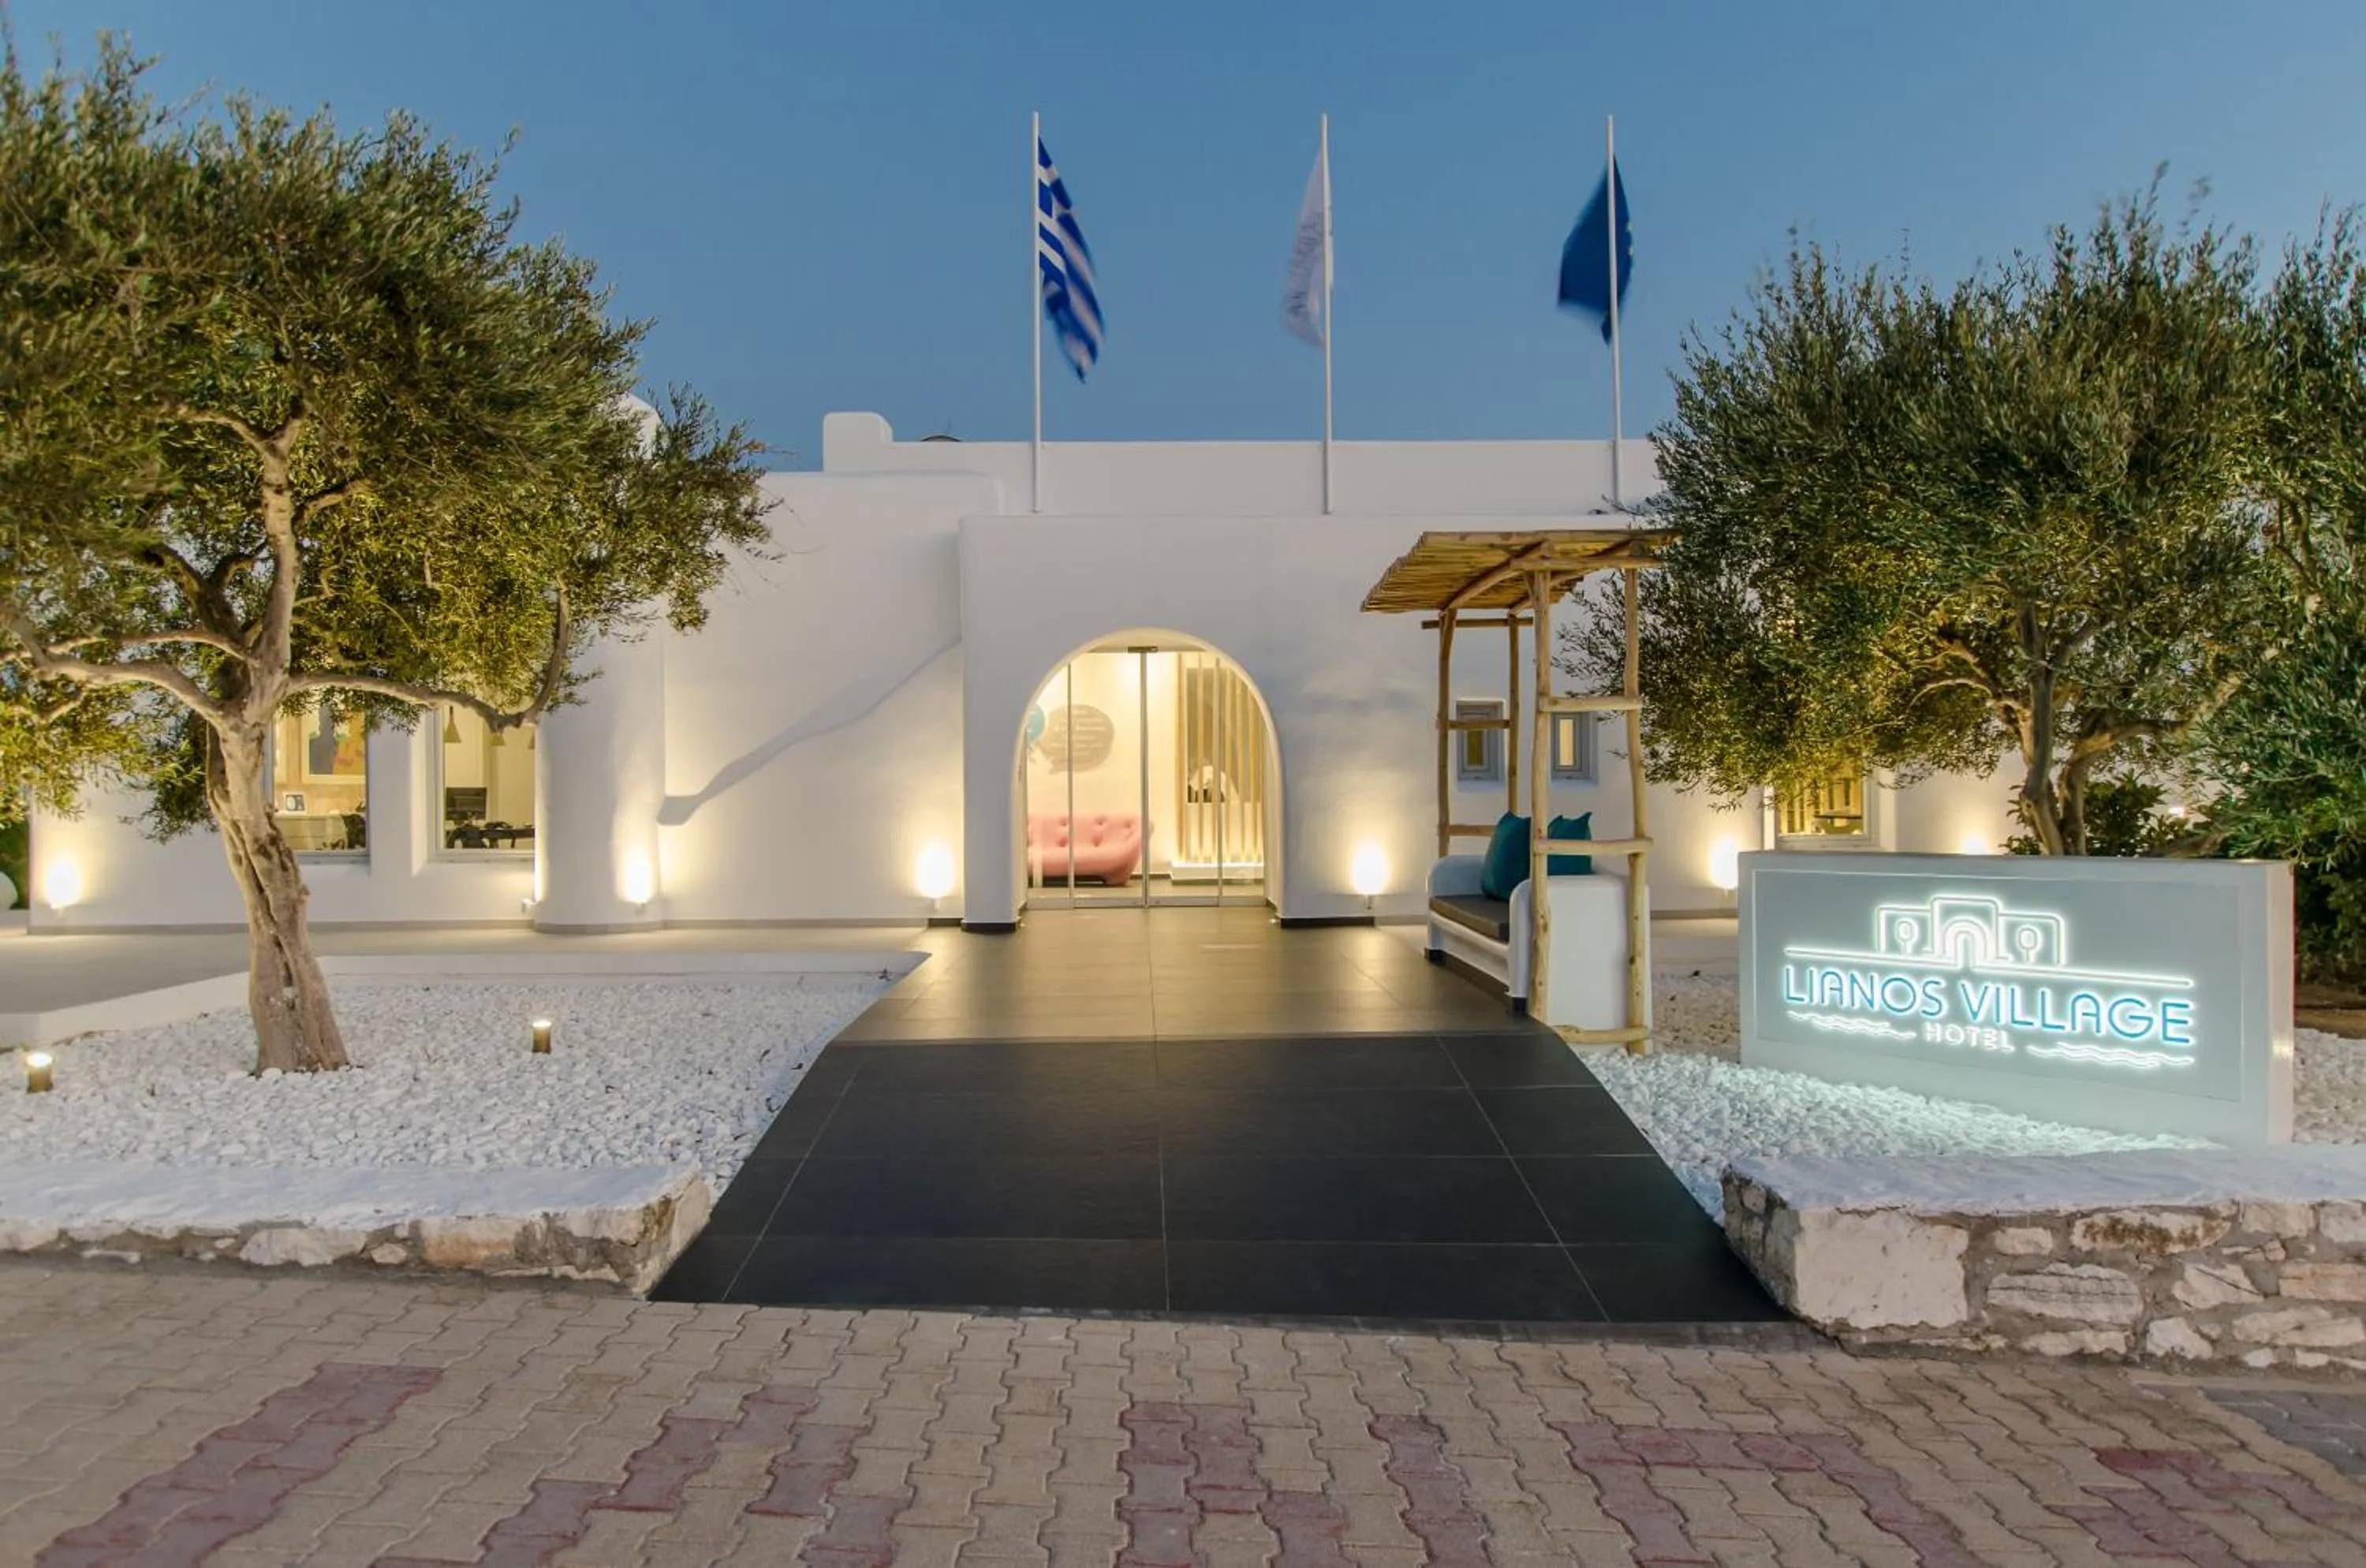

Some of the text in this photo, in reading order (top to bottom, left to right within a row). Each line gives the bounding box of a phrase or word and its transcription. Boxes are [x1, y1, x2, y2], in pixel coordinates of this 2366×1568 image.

[1783, 965, 2192, 1044] LIANOS VILLAGE
[1923, 1021, 2015, 1052] HOTEL
